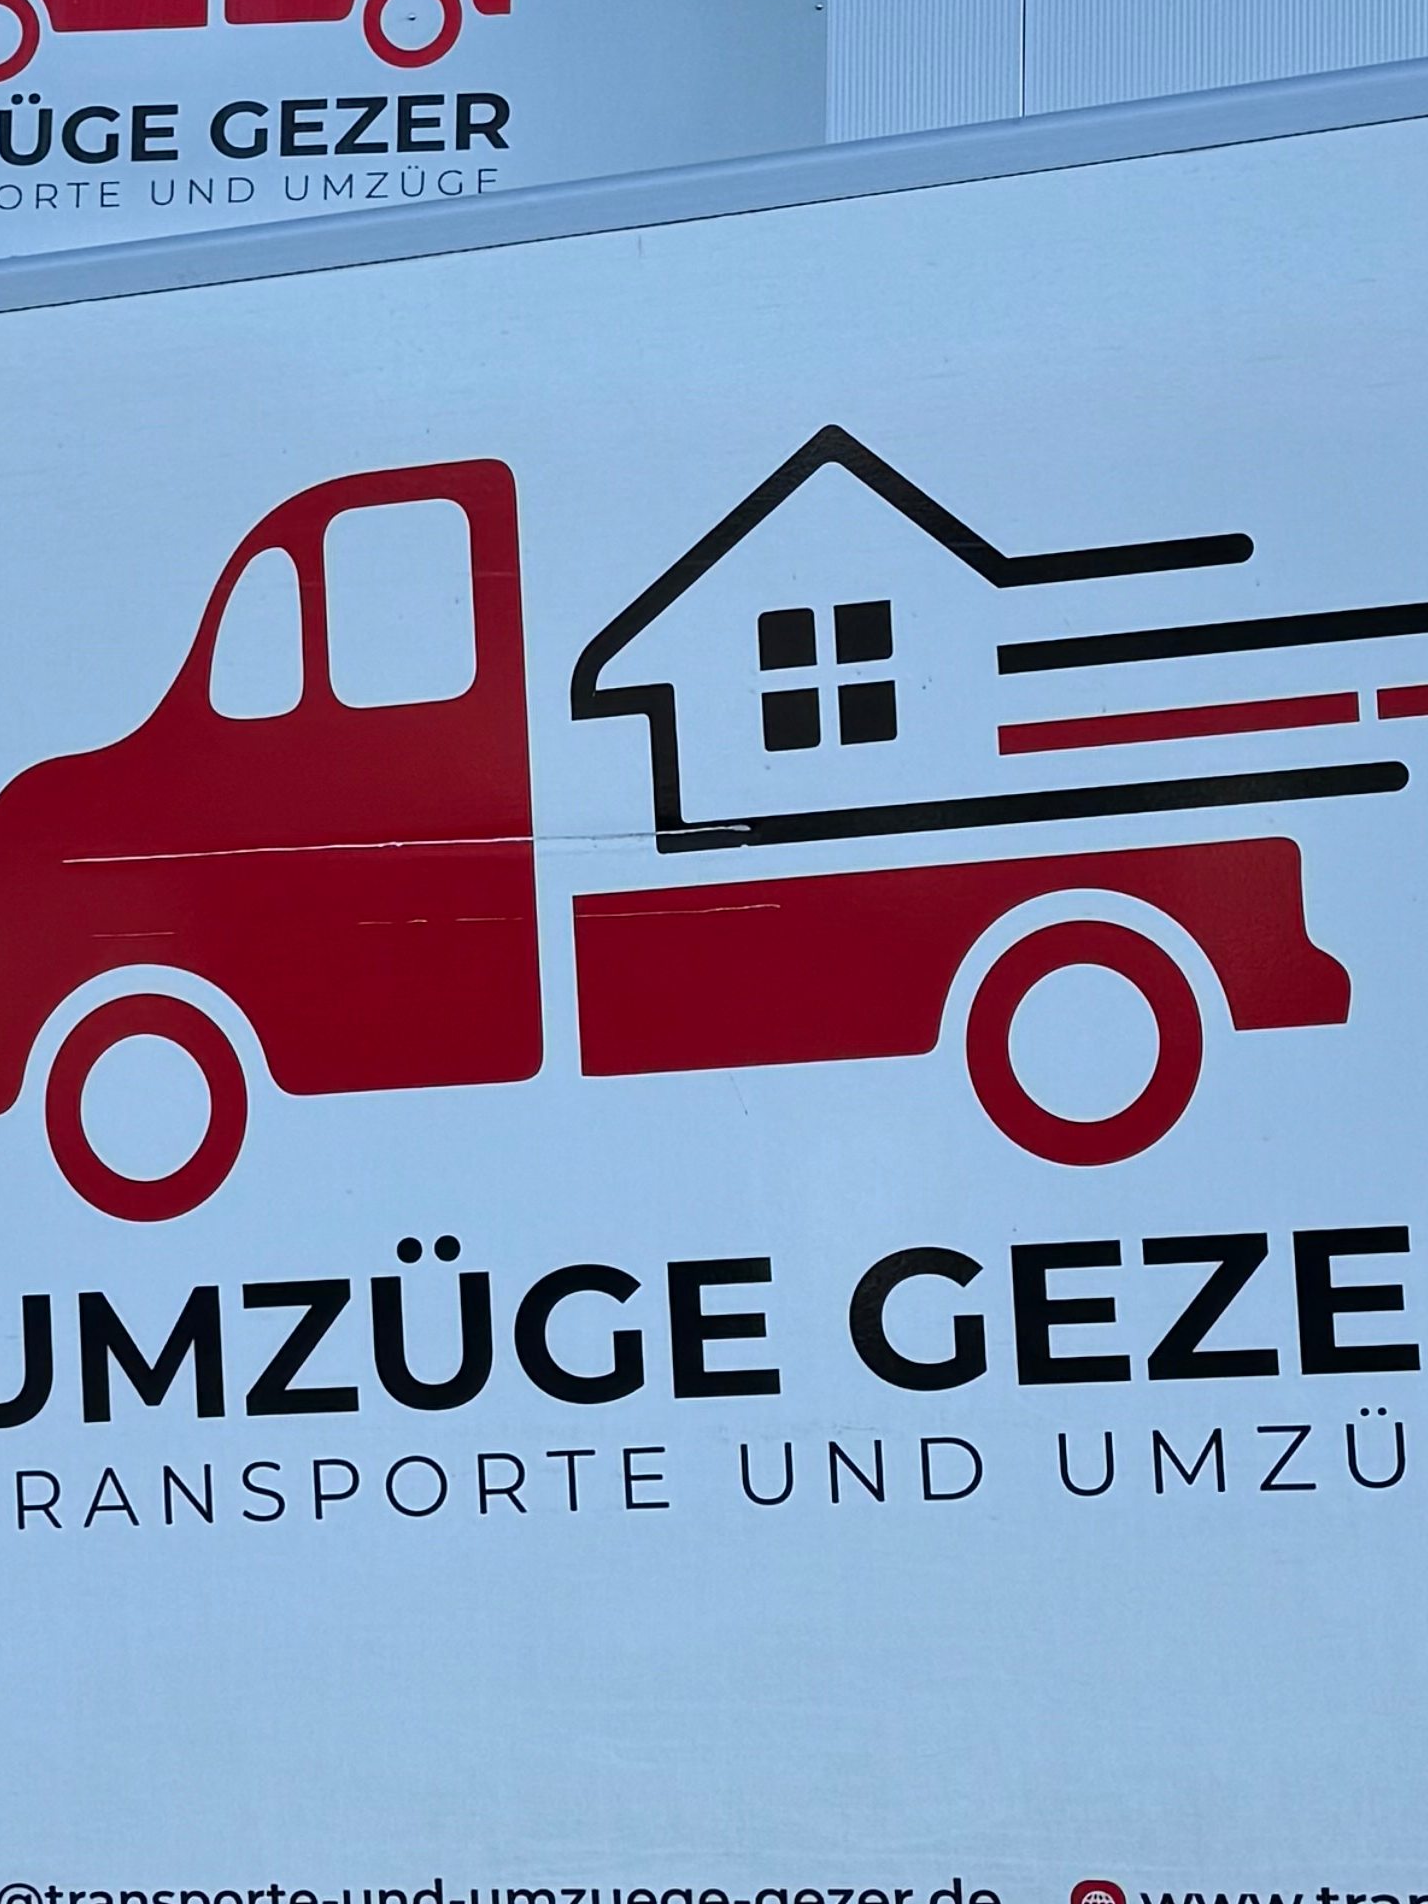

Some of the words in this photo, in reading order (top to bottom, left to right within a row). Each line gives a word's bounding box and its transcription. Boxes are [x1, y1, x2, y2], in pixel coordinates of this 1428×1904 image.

[209, 92, 510, 160] GEZER
[151, 177, 255, 206] UND
[740, 1437, 983, 1506] UND
